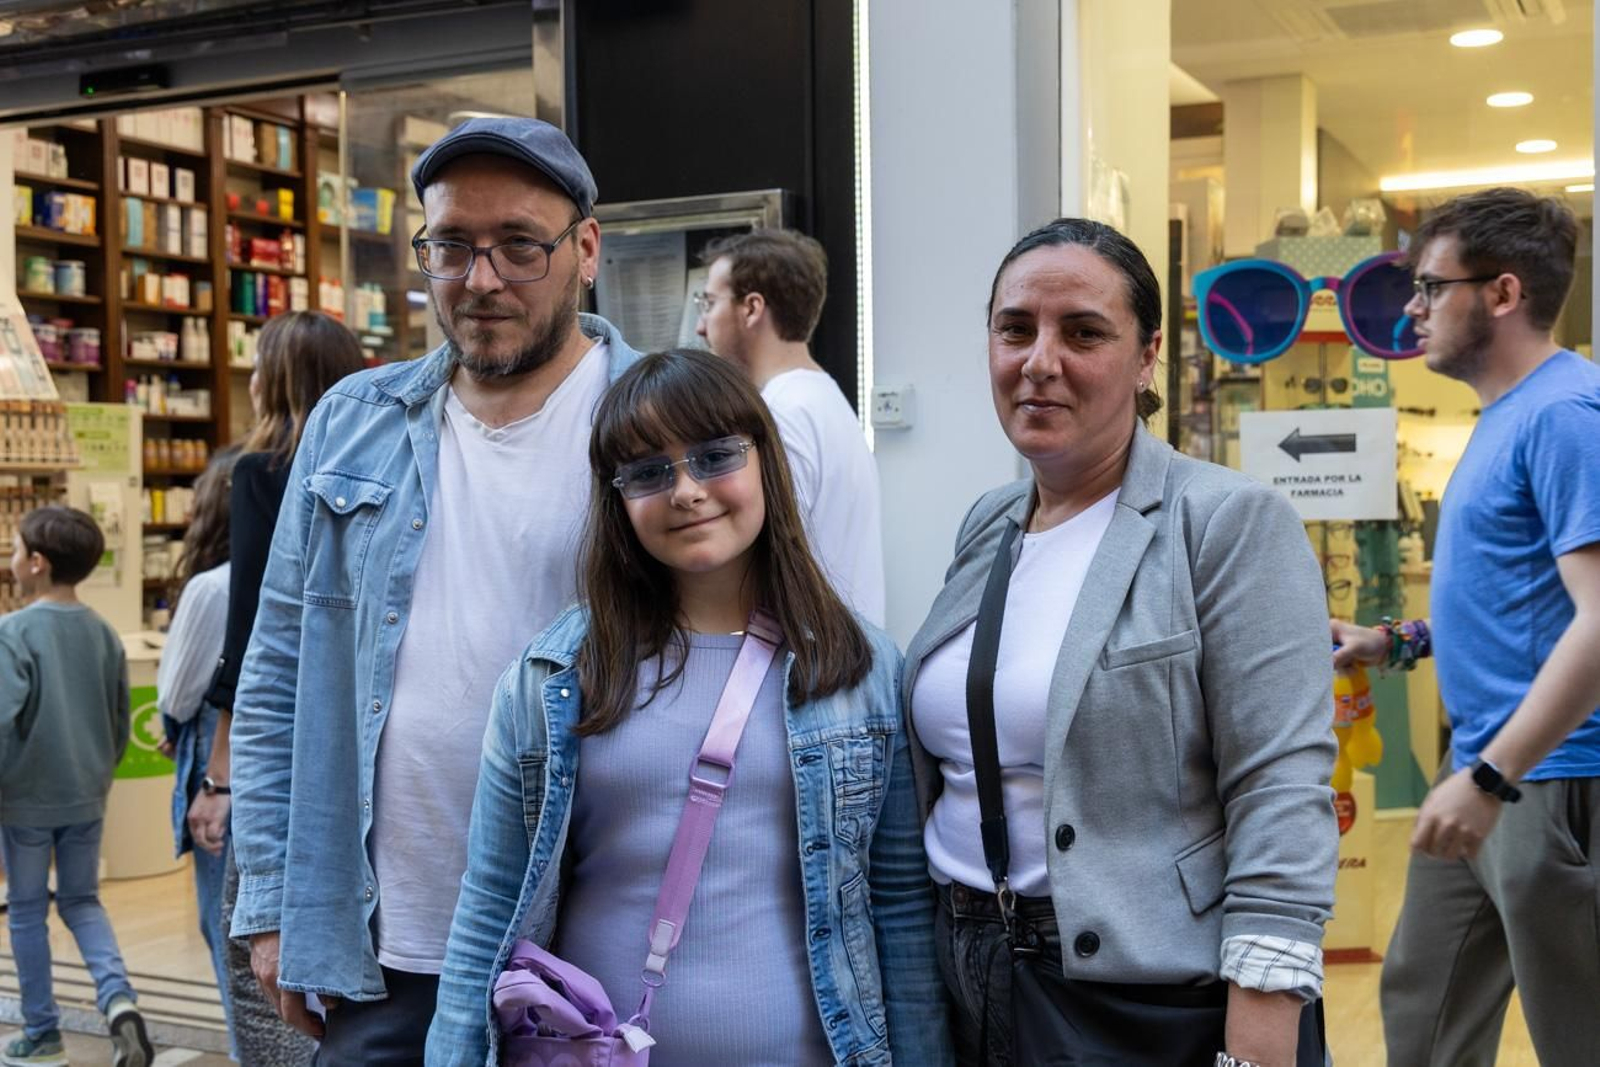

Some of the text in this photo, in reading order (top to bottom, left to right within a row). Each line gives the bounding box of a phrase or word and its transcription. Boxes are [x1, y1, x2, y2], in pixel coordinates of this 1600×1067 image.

[1273, 474, 1362, 485] ENTRADA POR LA
[1291, 488, 1344, 498] FARMACIA
